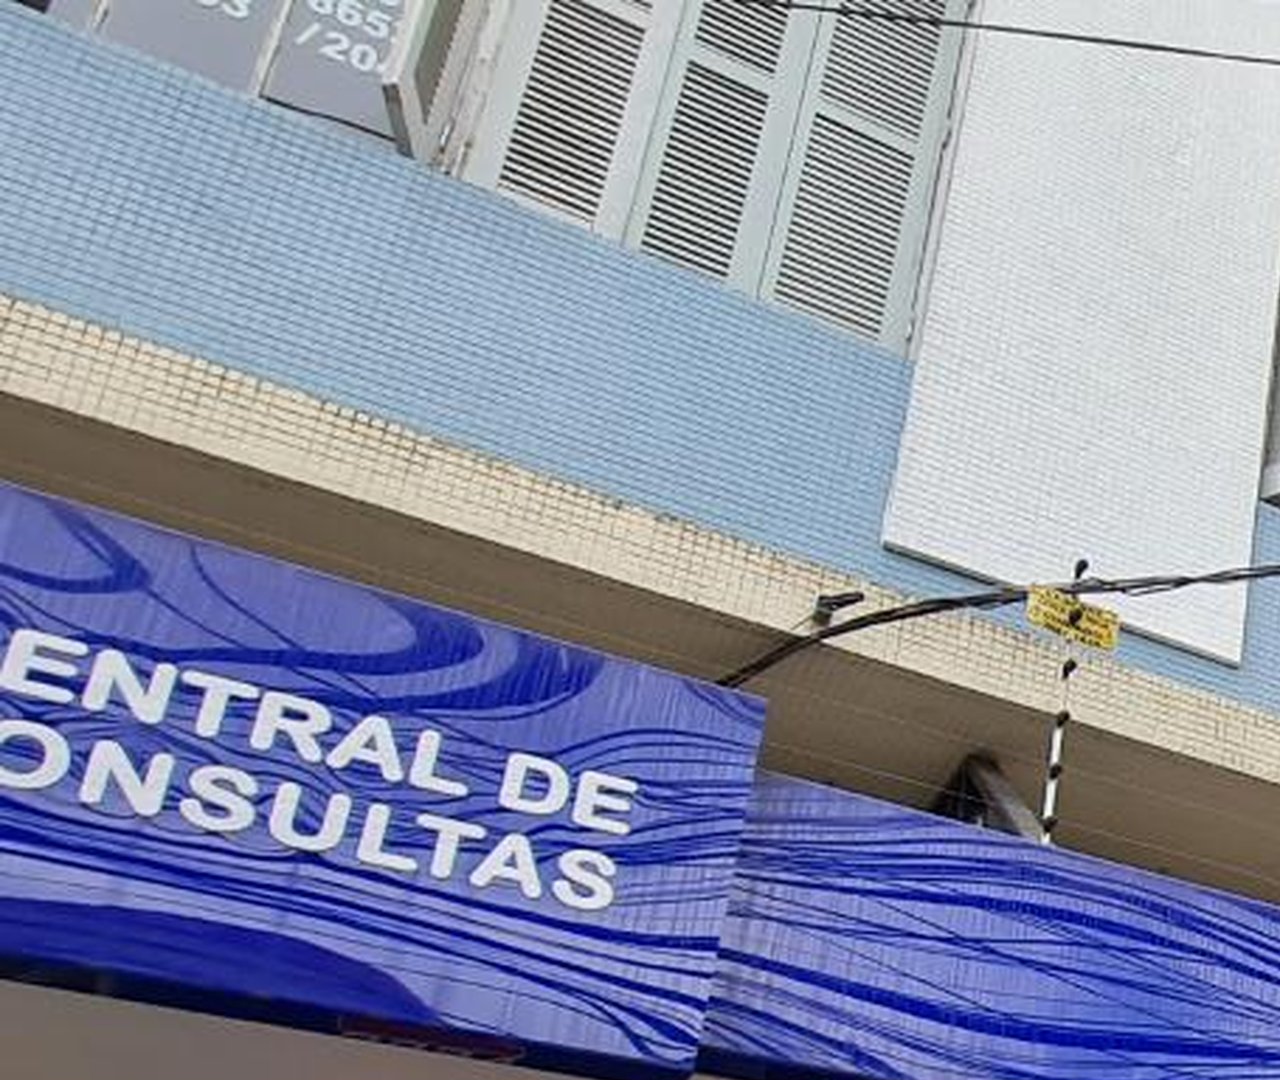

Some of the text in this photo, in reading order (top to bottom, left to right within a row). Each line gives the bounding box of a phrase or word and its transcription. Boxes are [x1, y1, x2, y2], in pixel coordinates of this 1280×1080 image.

[0, 628, 638, 835] ENTRAL DE
[0, 719, 617, 910] ONSULTAS
